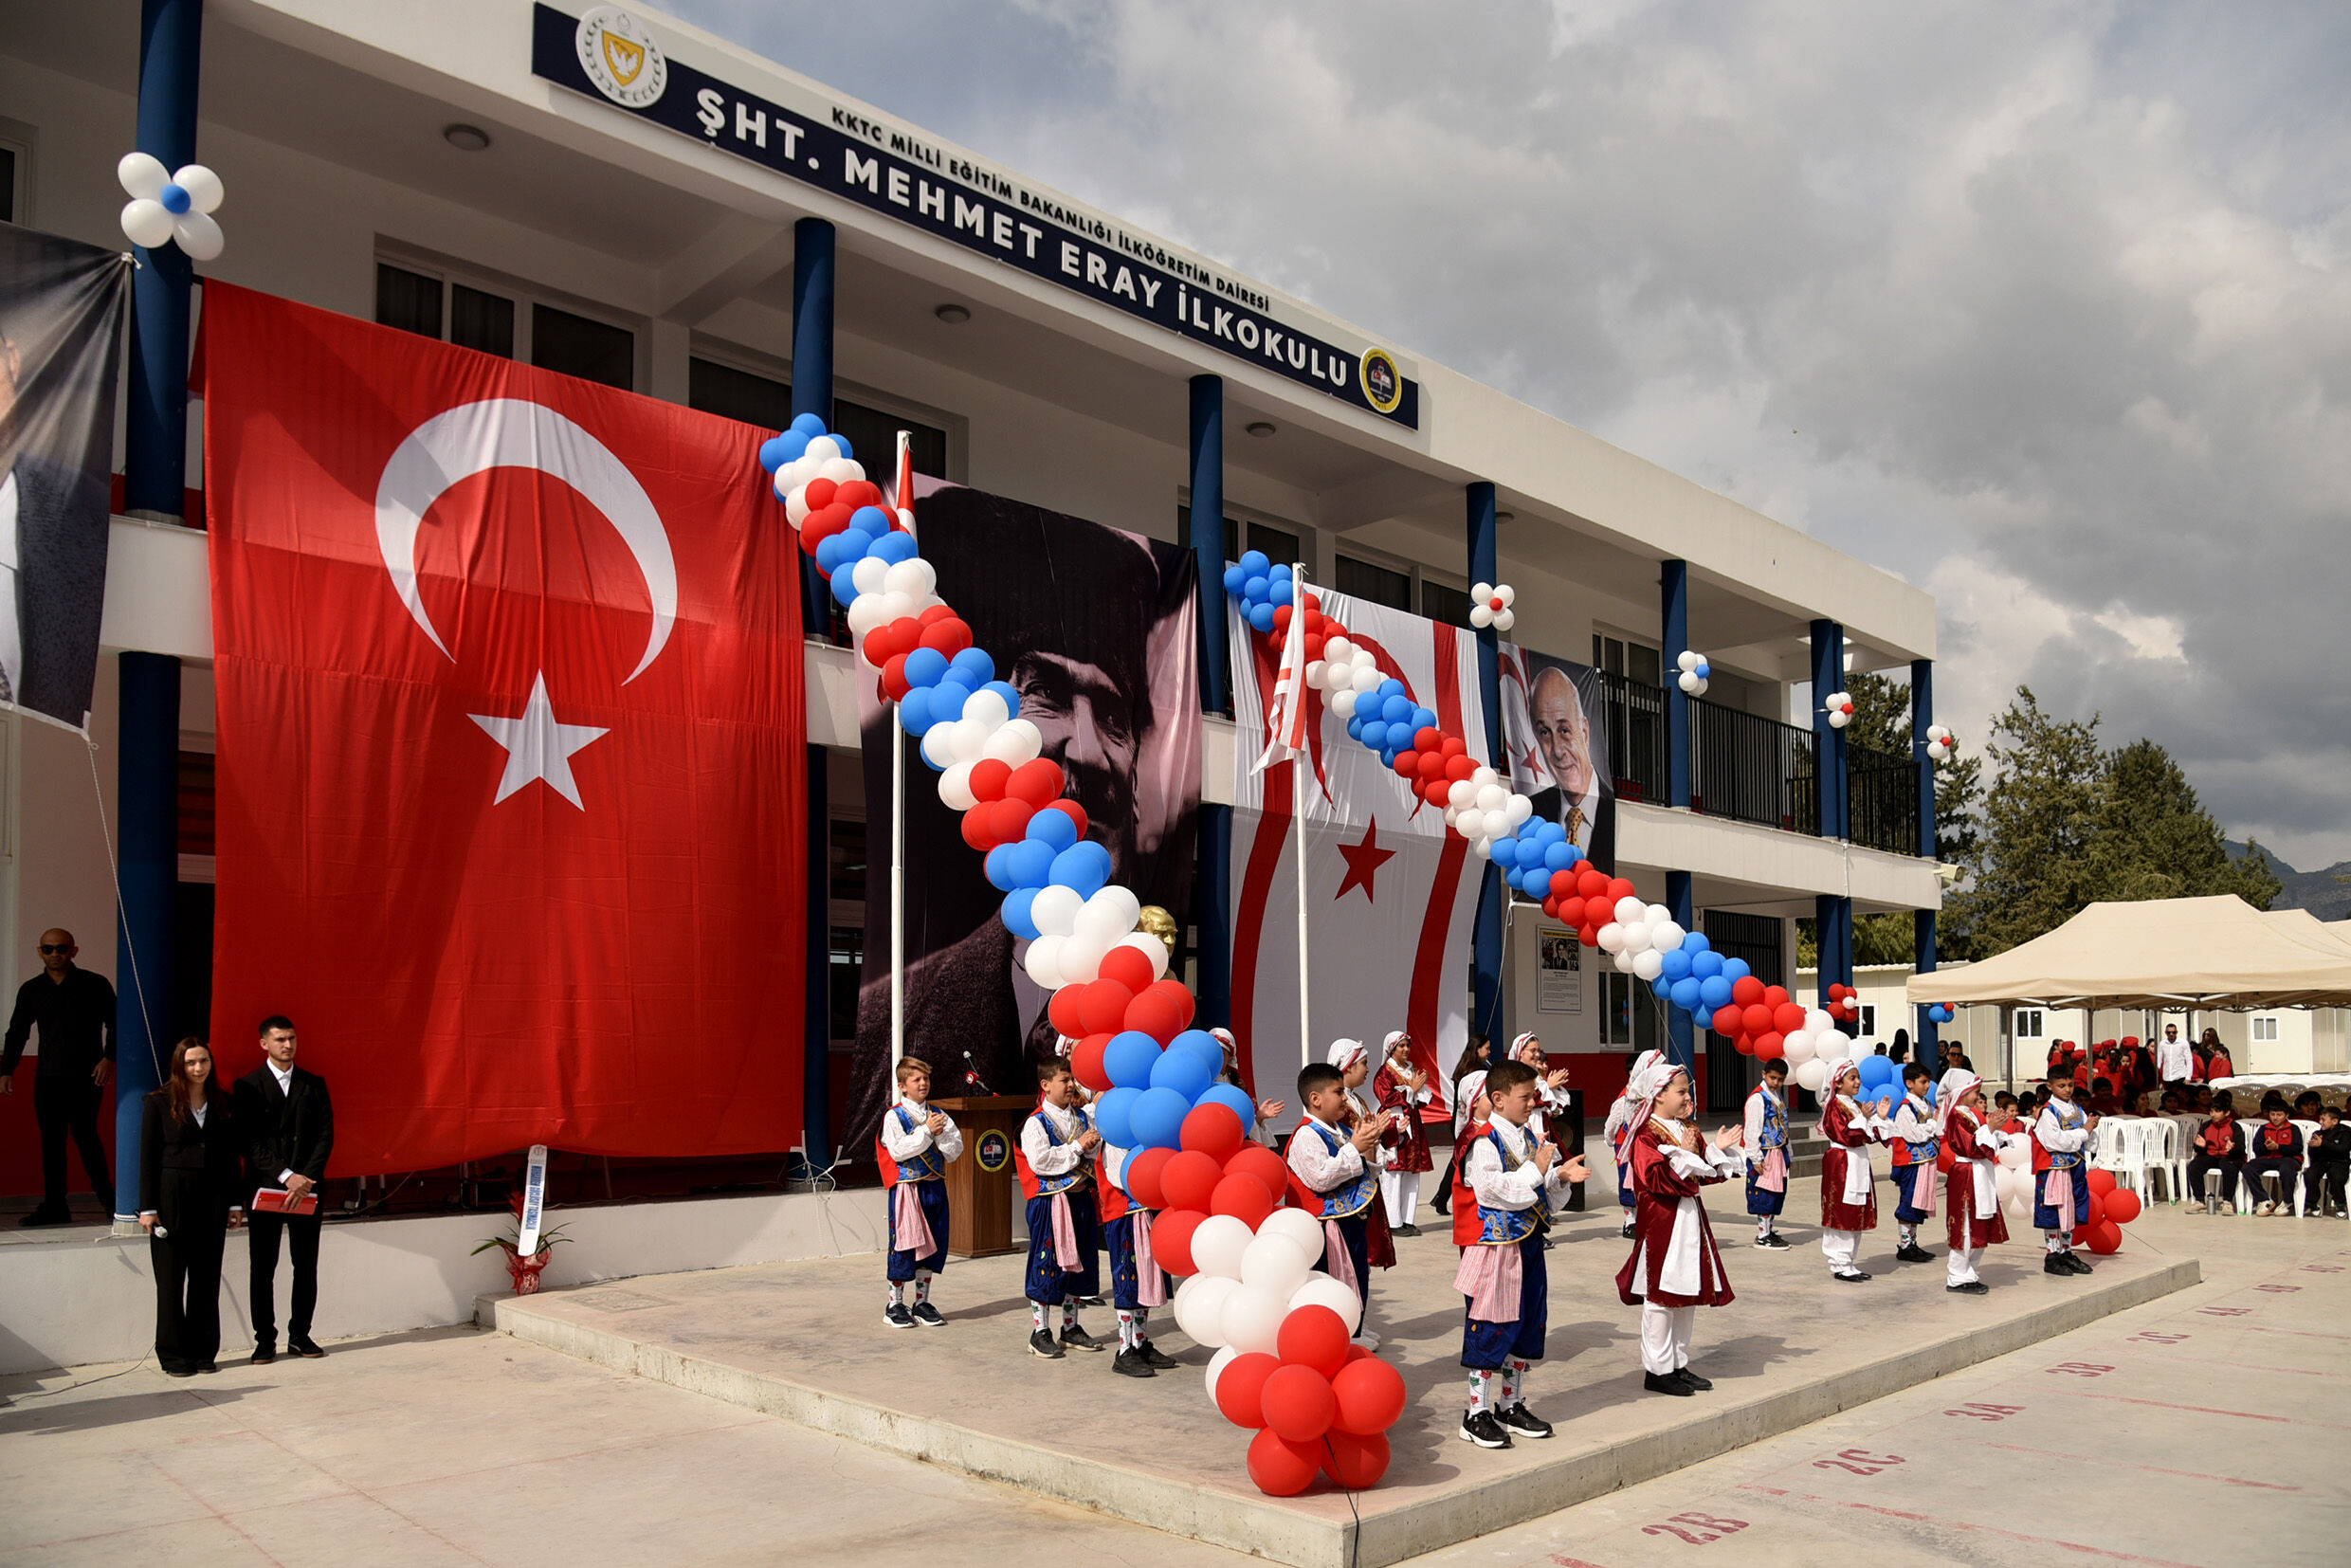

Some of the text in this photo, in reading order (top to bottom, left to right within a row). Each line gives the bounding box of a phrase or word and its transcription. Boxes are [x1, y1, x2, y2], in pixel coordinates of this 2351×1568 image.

[831, 106, 1270, 313] KKTC MİLLİ EĞİTİM BAKANLIĞI İLKÖĞRETİM DAİRESİ
[696, 88, 820, 170] ŞHT.
[844, 148, 1043, 259] MEHMET
[1060, 240, 1162, 308] ERAY
[1177, 283, 1348, 387] İLKOKULU
[2196, 1306, 2253, 1317] 4A
[2126, 1331, 2192, 1344] 3C
[2045, 1361, 2116, 1377] 3B
[1943, 1402, 2027, 1421] 3A
[1813, 1449, 1906, 1476] 2C
[1641, 1511, 1750, 1545] 2B
